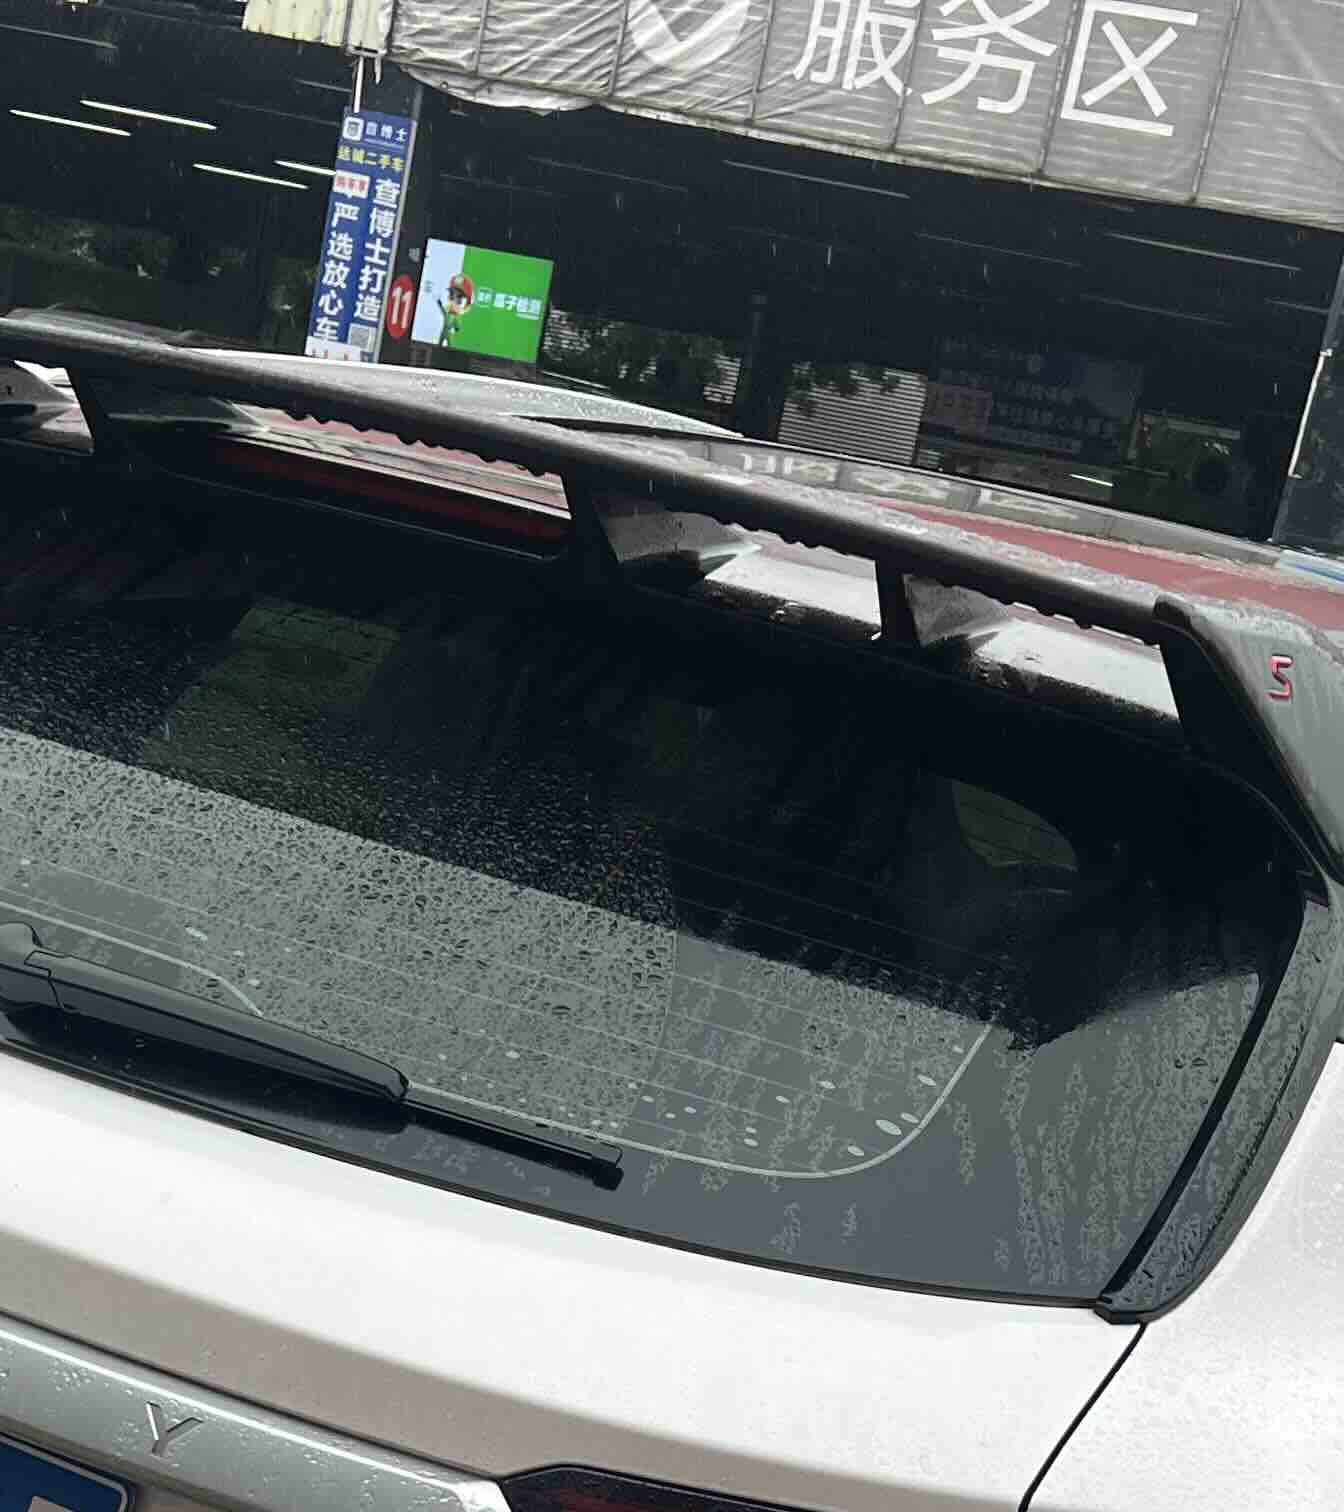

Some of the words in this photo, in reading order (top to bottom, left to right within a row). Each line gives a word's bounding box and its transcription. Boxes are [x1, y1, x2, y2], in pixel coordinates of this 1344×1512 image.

[793, 0, 1197, 136] 服务区
[314, 202, 360, 341] 严选放心车
[355, 178, 400, 321] 查博士打造
[390, 285, 414, 330] 11
